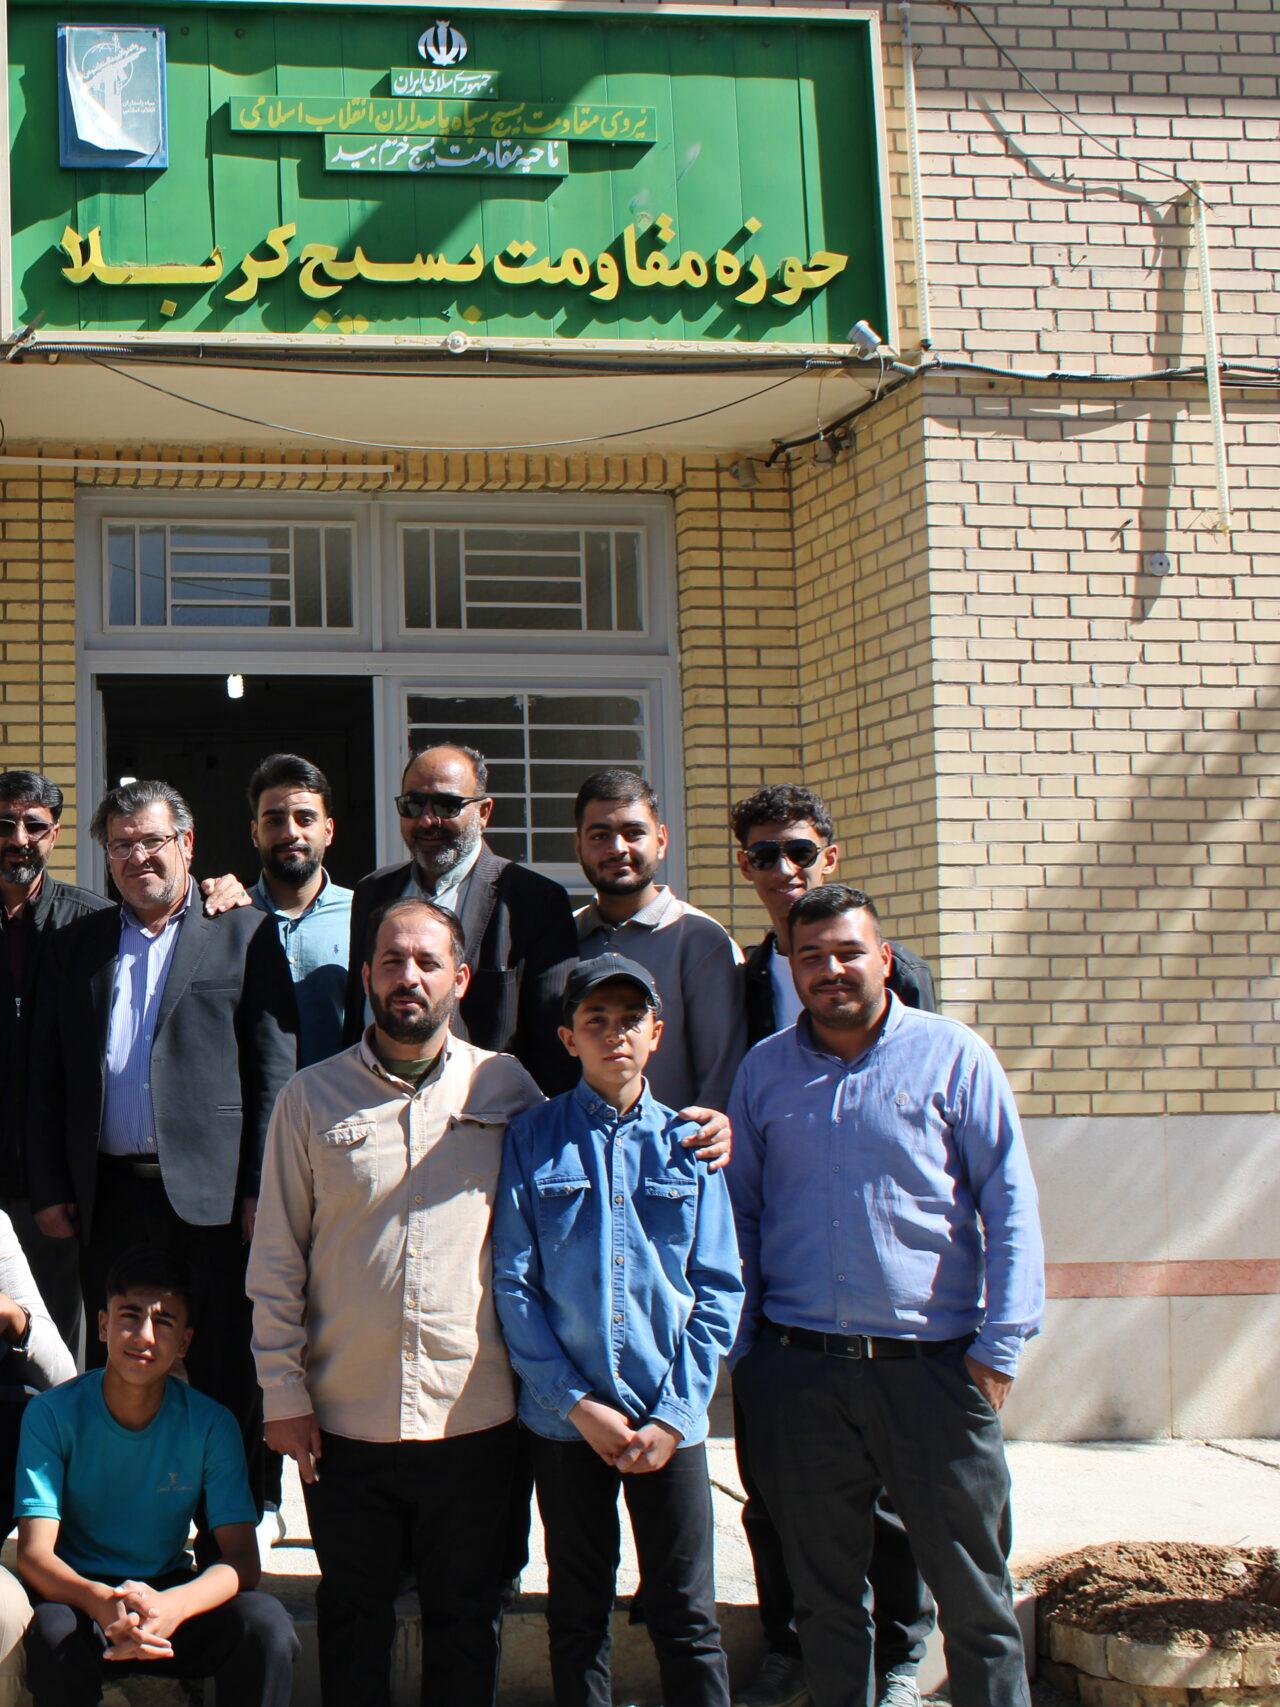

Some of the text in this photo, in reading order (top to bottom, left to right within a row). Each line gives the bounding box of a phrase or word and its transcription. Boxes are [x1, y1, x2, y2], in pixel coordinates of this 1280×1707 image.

[394, 69, 494, 96] جمهوری اسلامی ایران
[239, 96, 648, 143] نیروی مقاومت بسیج سپاه پاسداران انقلاب اسلامی
[331, 144, 378, 169] بید
[408, 137, 436, 172] بسیج
[435, 140, 523, 169] مقاومت
[515, 141, 560, 173] ناحیه
[60, 212, 849, 333] حوزه مقاومت بسیج کربلا
